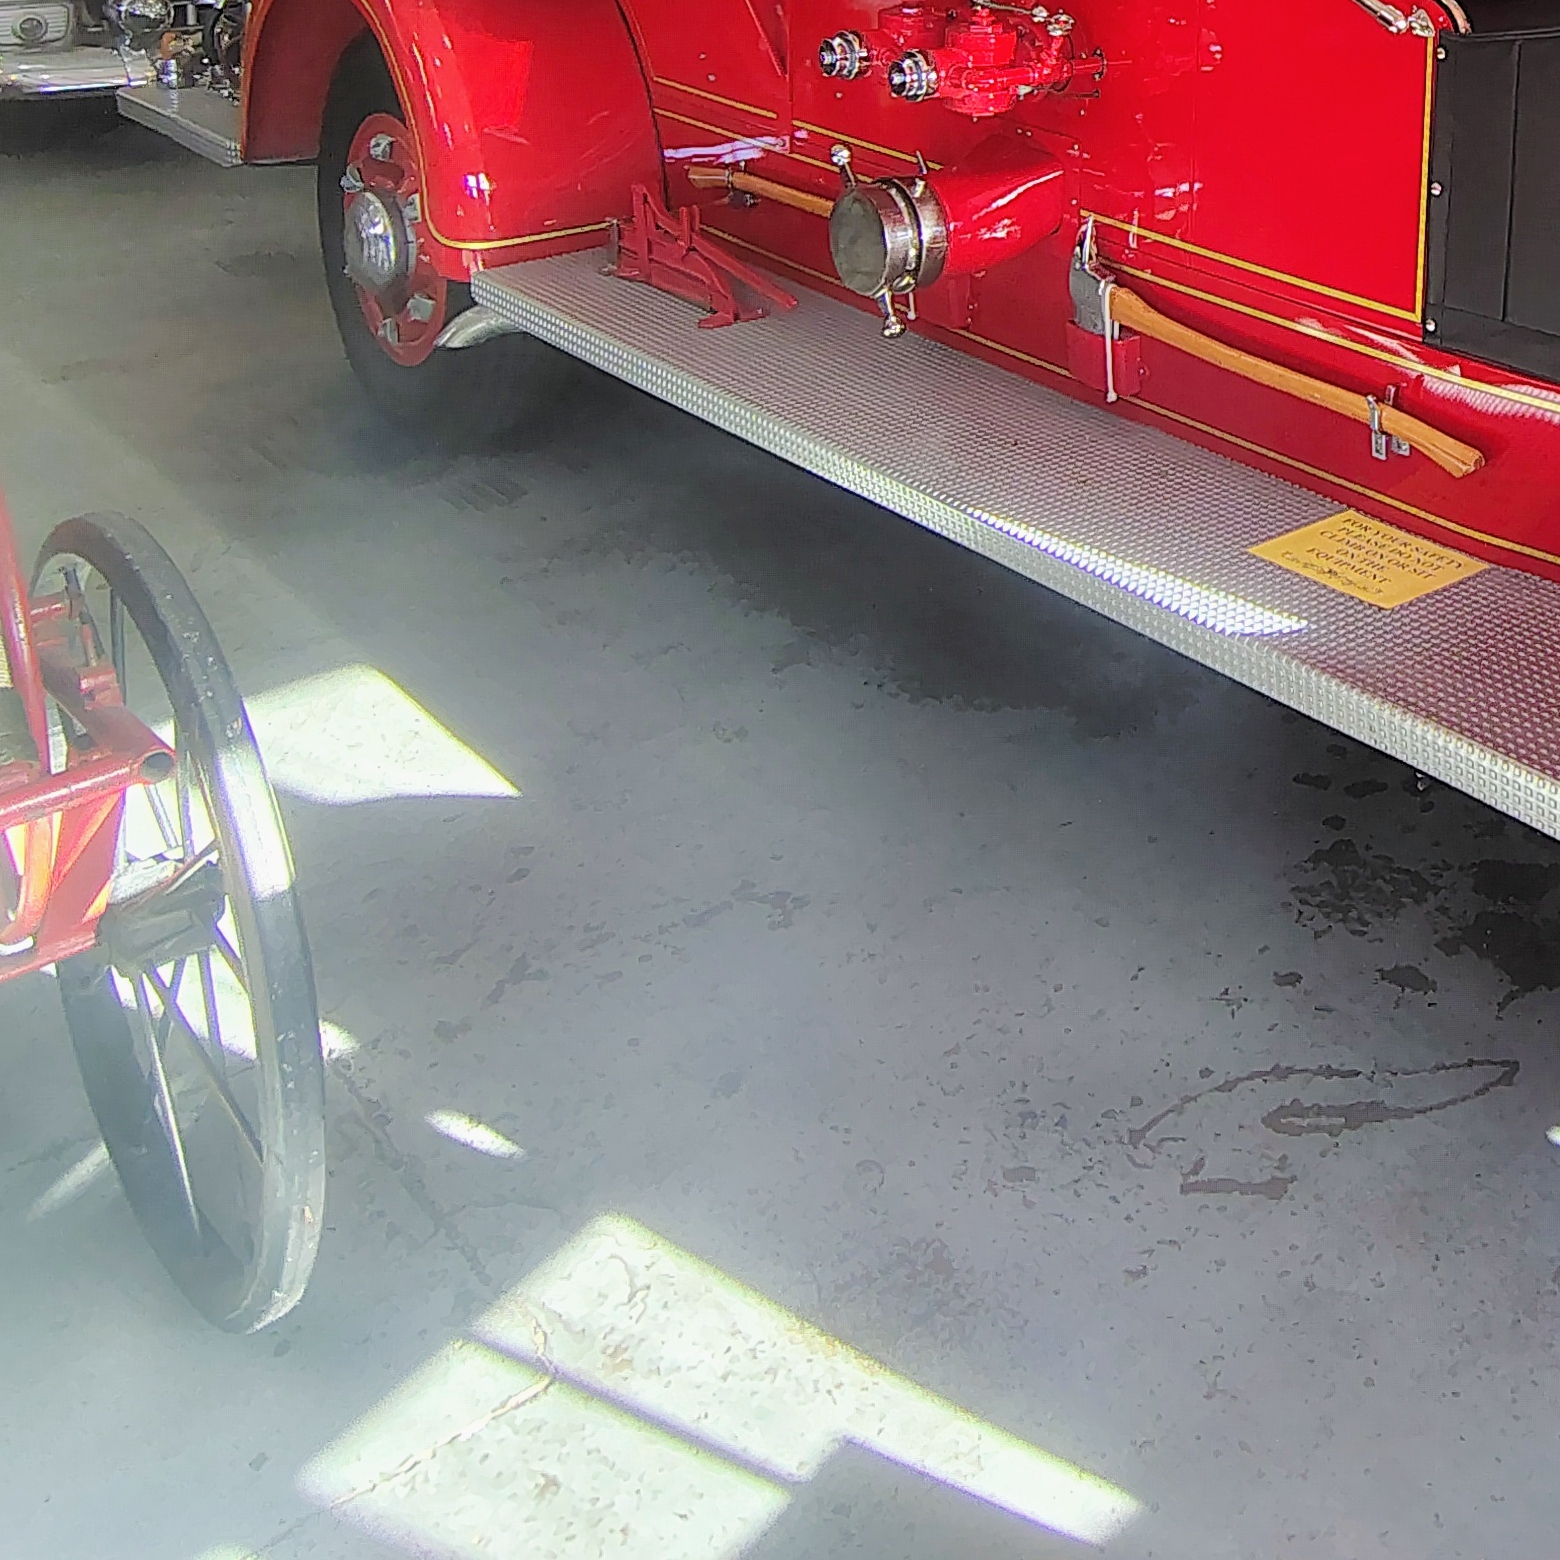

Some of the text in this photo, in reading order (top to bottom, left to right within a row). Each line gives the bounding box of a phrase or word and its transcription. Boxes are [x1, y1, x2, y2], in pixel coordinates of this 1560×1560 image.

[1306, 547, 1392, 584] EQUIPMENT
[1319, 530, 1438, 580] CLIMB ON OR SIT
[1336, 547, 1390, 572] ON THE
[1337, 526, 1446, 572] PLEASE DO NOT
[1342, 518, 1463, 571] FOR YOUR SAFETY
